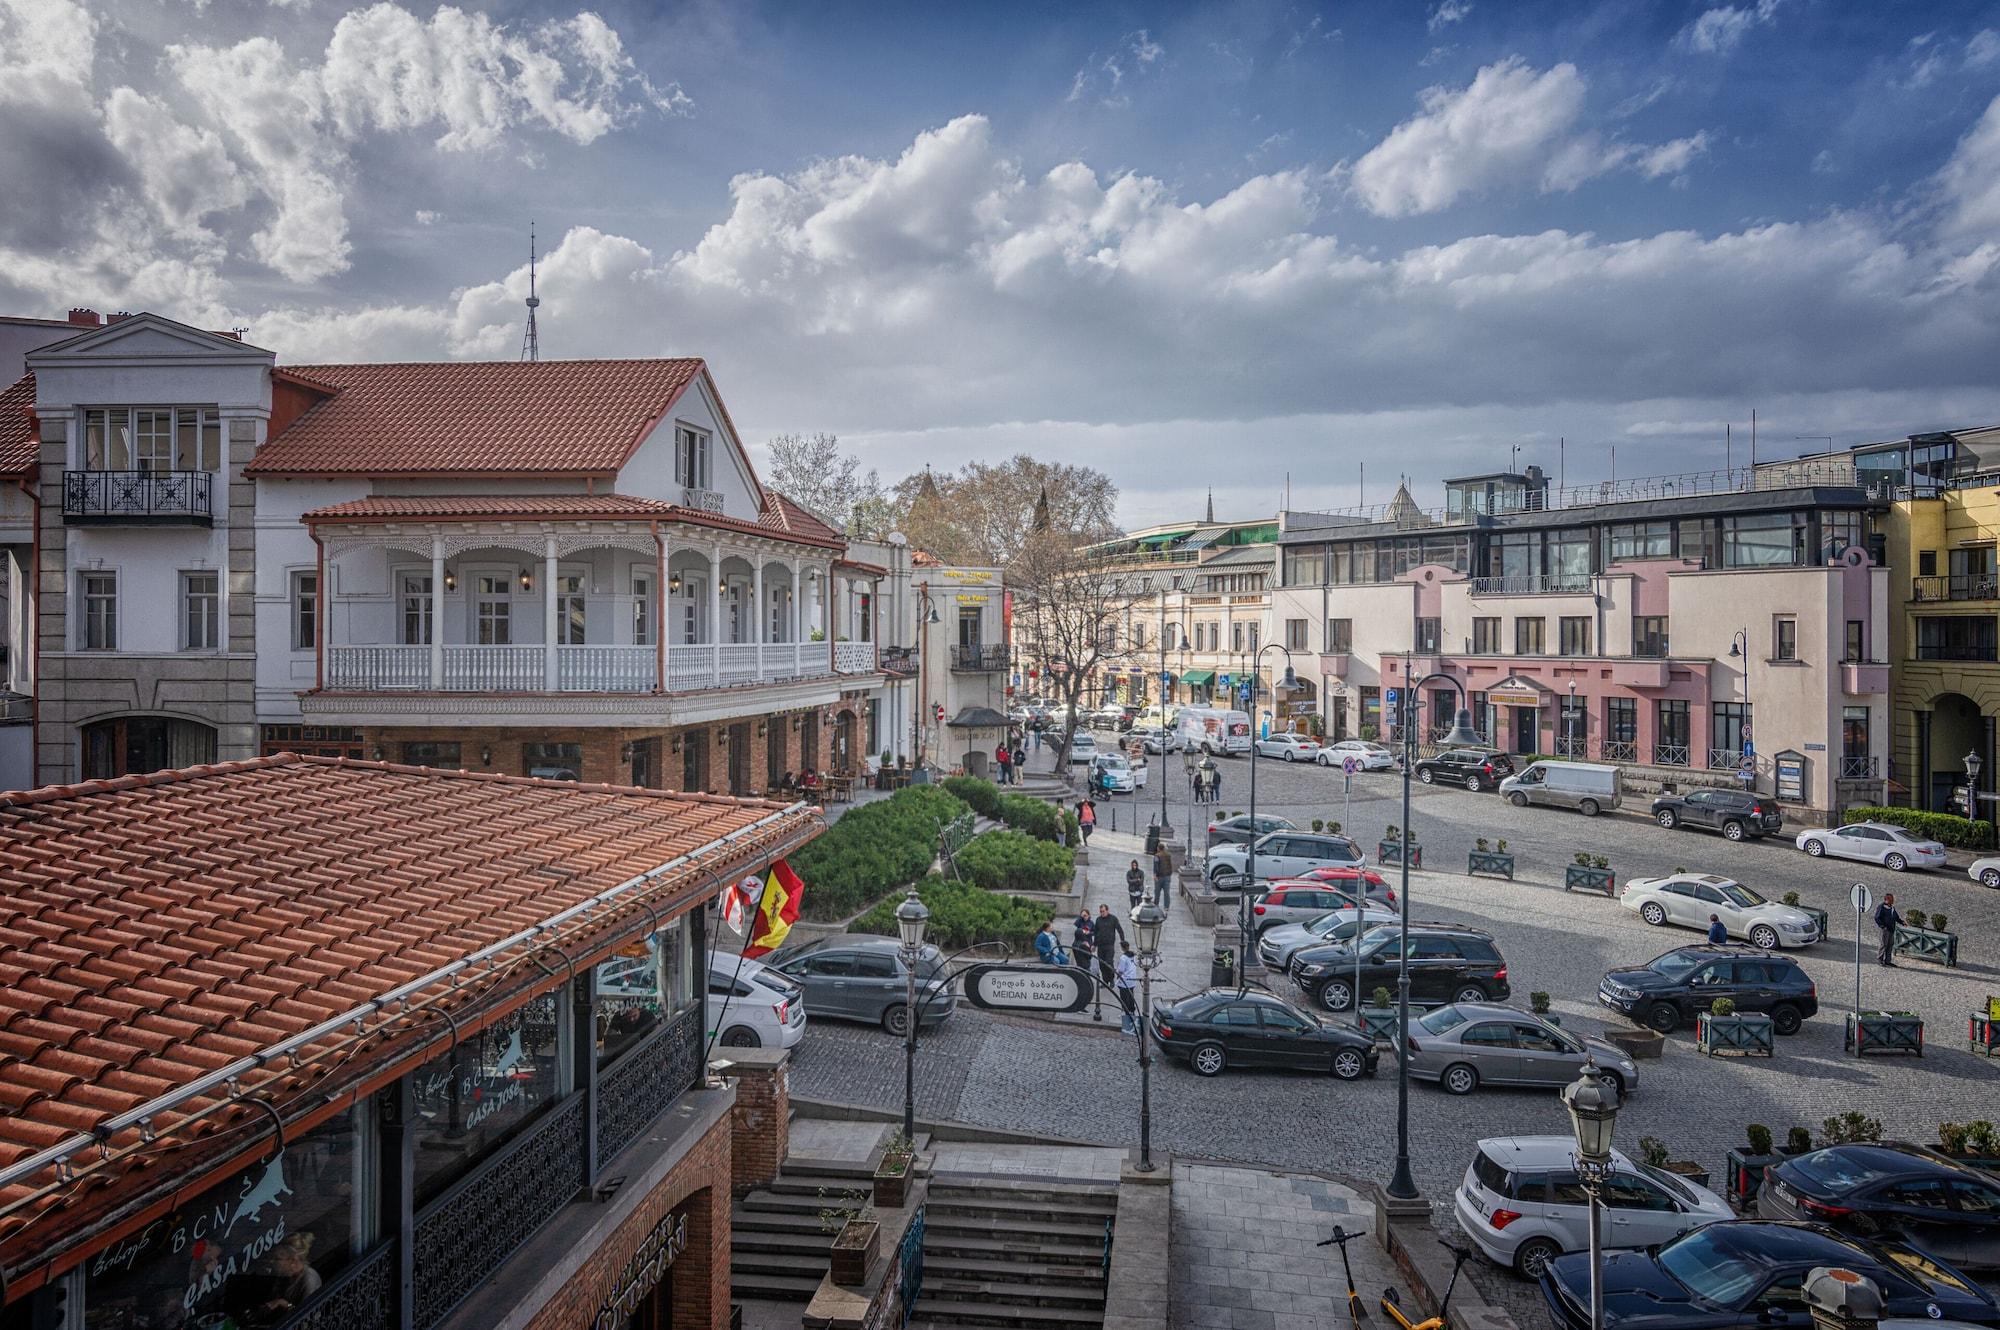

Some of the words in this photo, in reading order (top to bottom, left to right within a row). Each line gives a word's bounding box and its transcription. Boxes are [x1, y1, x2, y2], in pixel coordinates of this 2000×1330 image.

[991, 977, 1026, 990] მეიდან
[1030, 979, 1065, 990] ბაზარი
[992, 990, 1027, 1000] MEIDAN
[1033, 992, 1063, 1001] BAZAR
[466, 1098, 495, 1130] CASA
[183, 1258, 237, 1310] CASA
[241, 1215, 286, 1273] JOSÉ
